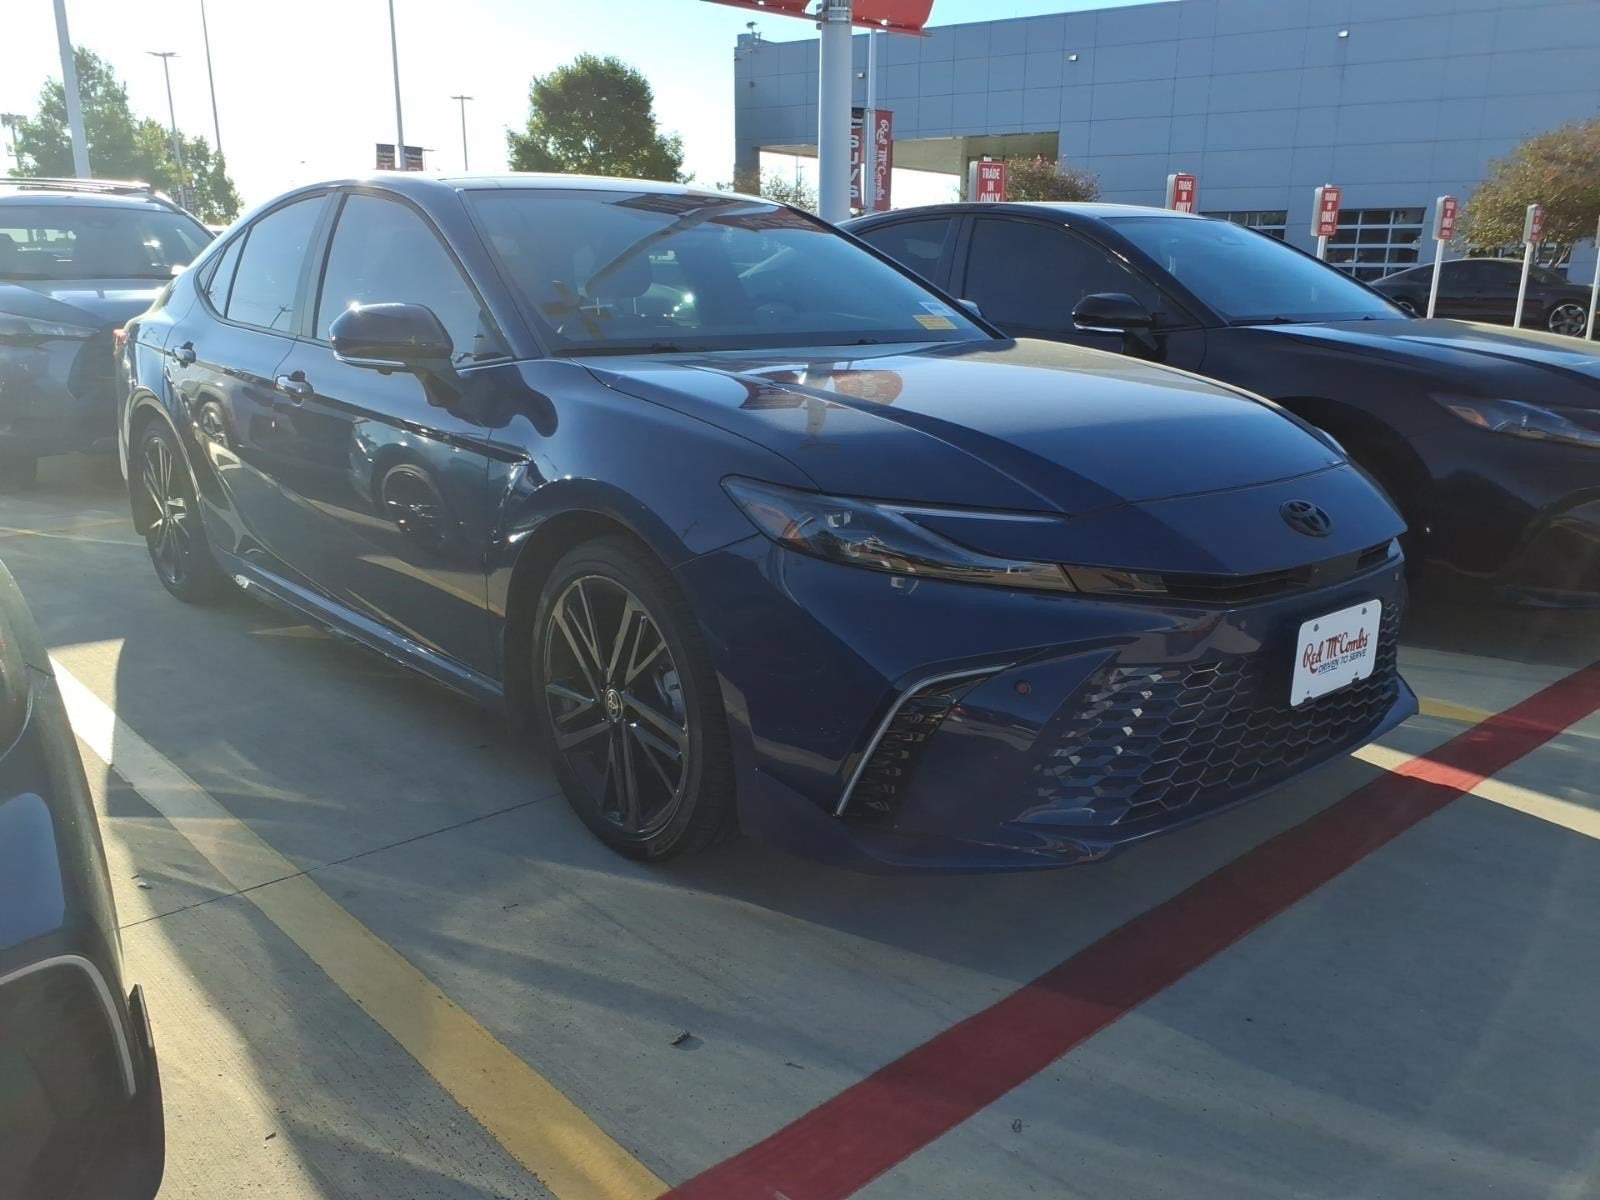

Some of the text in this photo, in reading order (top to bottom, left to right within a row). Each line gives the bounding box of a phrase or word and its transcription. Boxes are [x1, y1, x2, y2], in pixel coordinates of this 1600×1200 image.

[982, 168, 1000, 179] TRADE
[987, 180, 994, 192] IN
[980, 192, 1001, 203] ONLY
[1303, 627, 1368, 674] Red McCombs
[1318, 648, 1367, 673] DRIVEN TO SERVE
